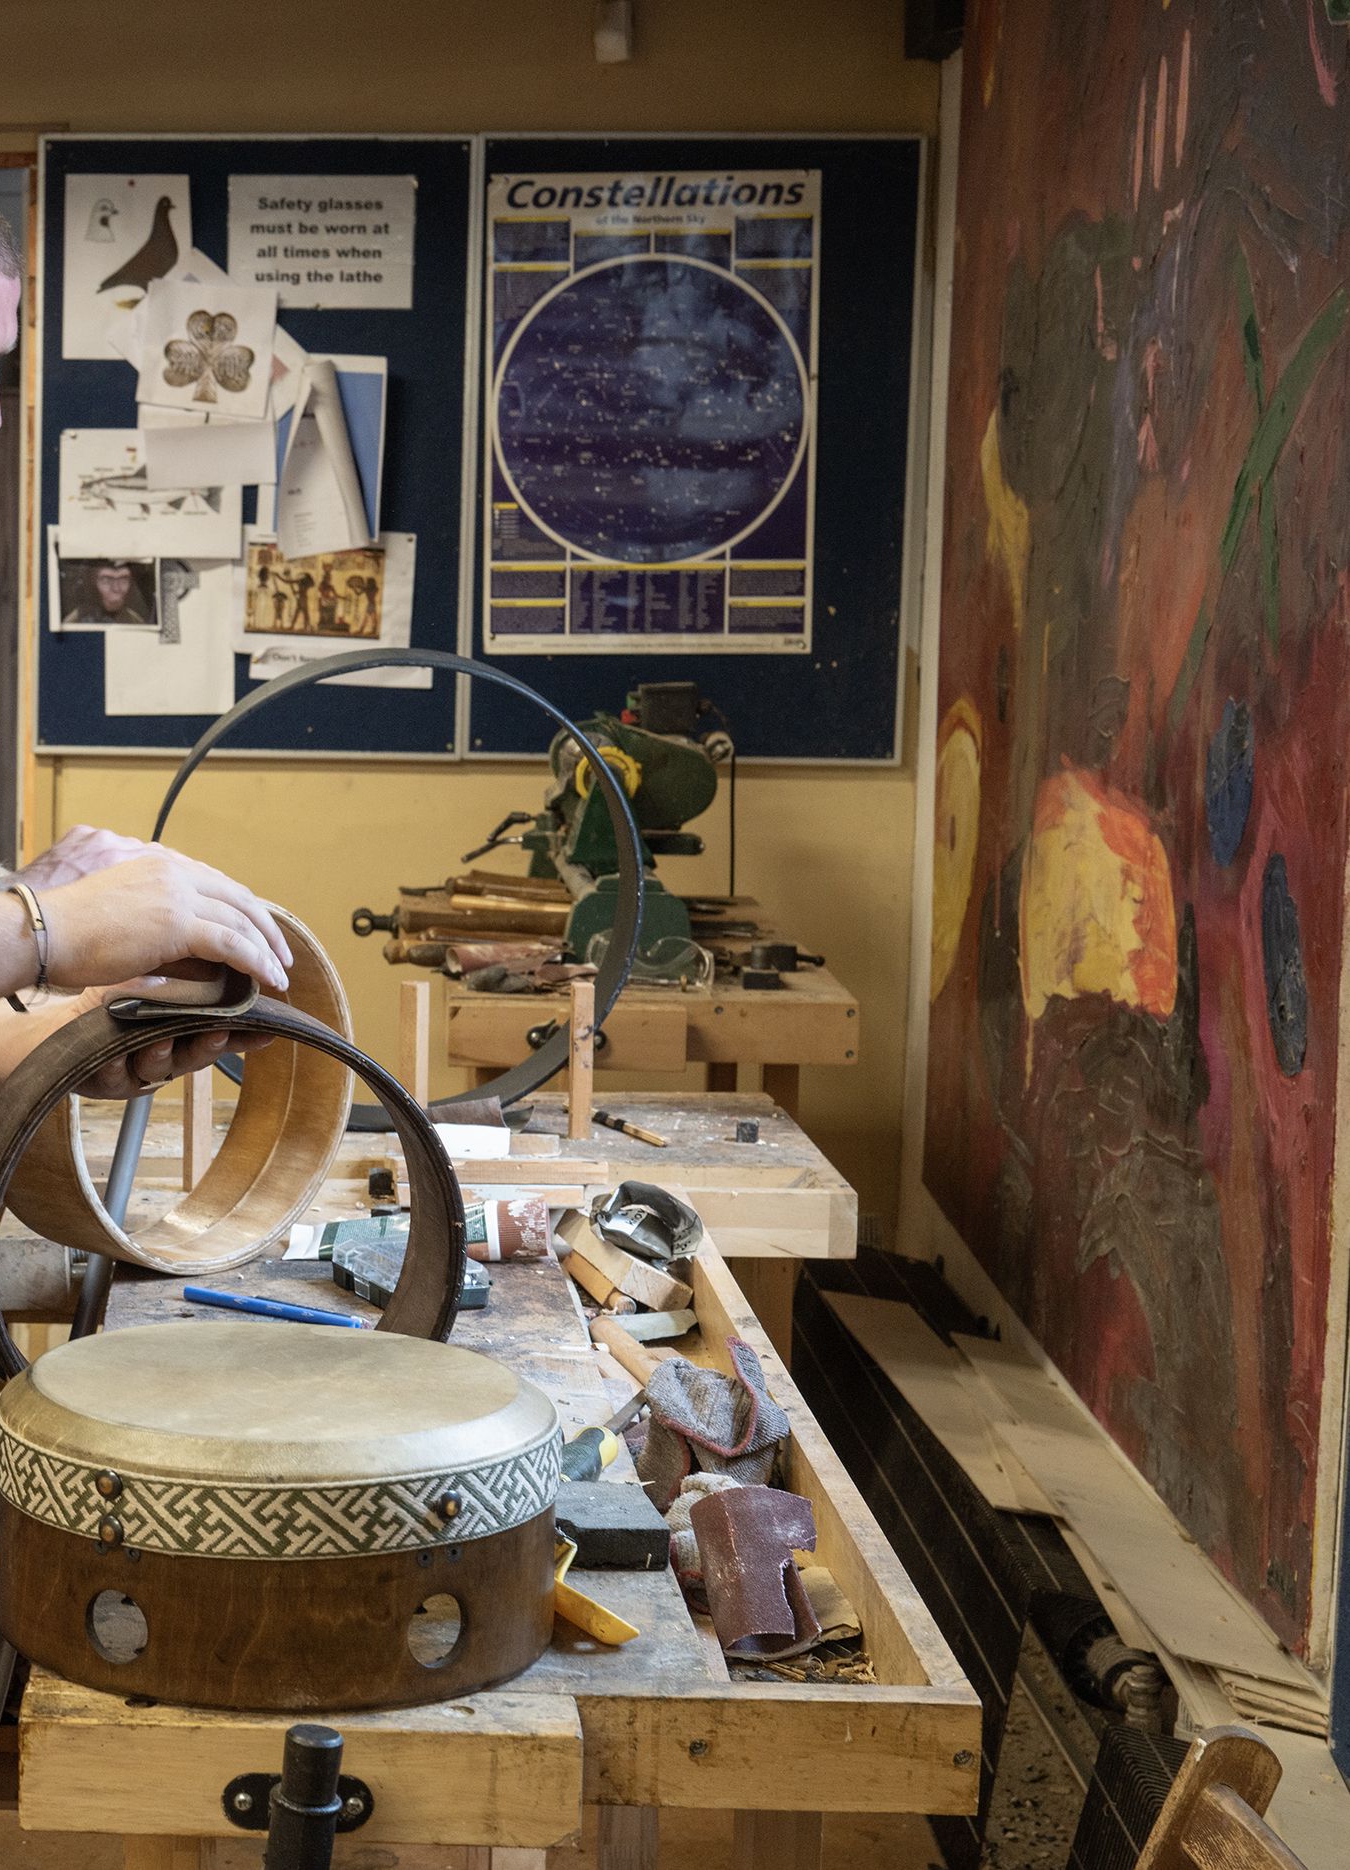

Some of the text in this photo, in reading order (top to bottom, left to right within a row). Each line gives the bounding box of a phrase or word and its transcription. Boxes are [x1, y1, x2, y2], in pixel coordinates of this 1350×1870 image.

[506, 176, 806, 209] Constellations
[257, 197, 384, 213] Safety glasses
[611, 213, 629, 224] the
[632, 213, 684, 224] Northern
[250, 221, 390, 235] must be worn at
[256, 245, 383, 259] all times when
[255, 269, 384, 286] using the lathe
